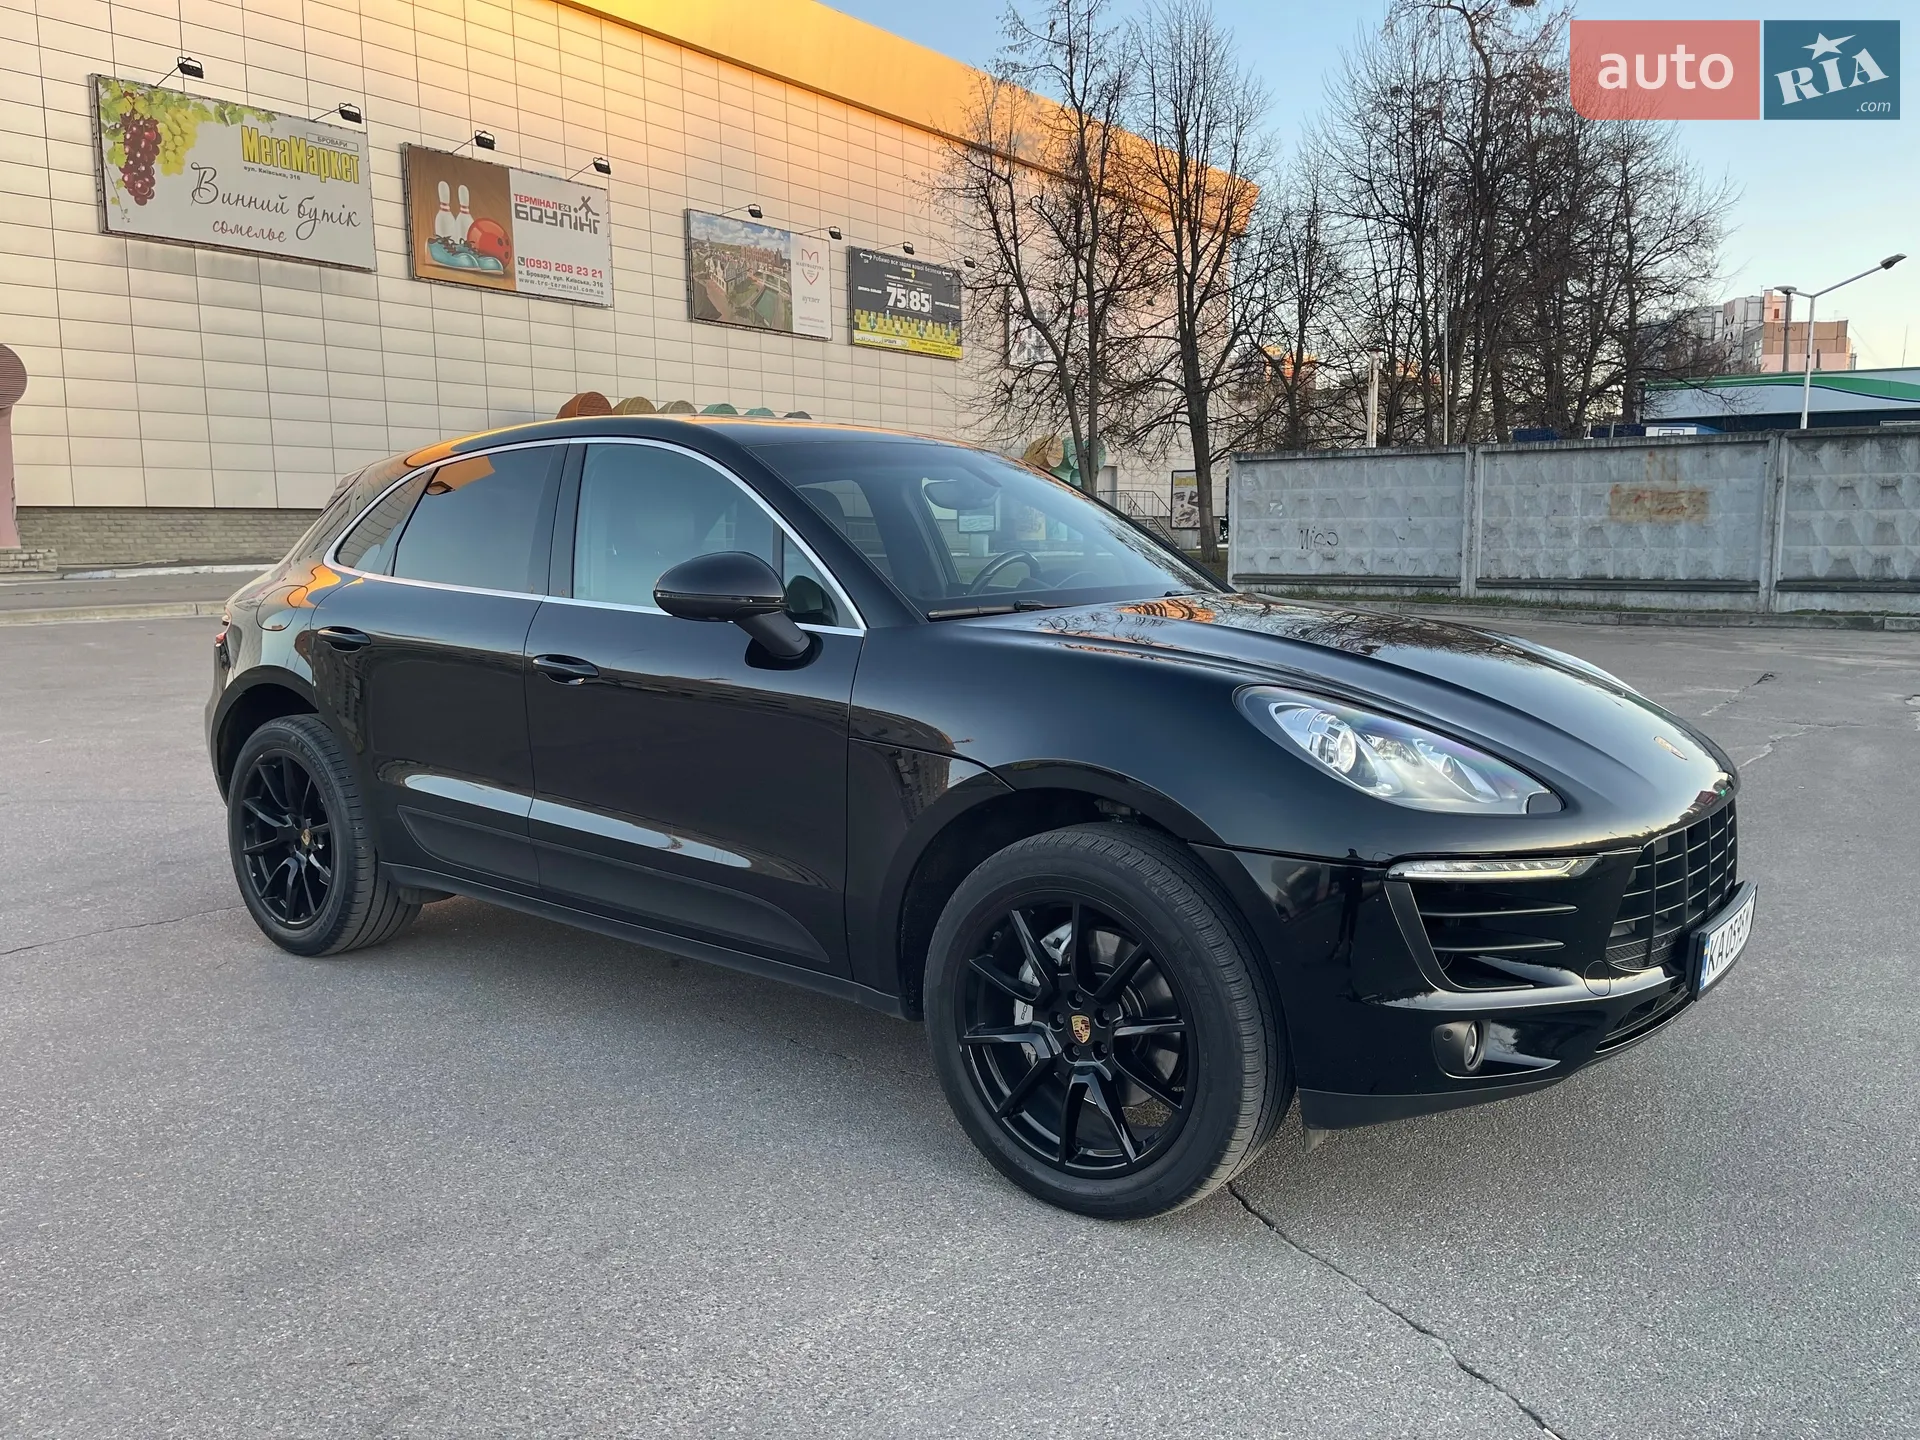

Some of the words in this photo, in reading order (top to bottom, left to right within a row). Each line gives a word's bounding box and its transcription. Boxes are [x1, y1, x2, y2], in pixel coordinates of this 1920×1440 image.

[241, 125, 360, 184] МегаМаркет
[317, 136, 348, 148] БРОВАРИ
[190, 162, 290, 215] Винний
[295, 196, 361, 241] бутік
[513, 193, 557, 210] ТЕРМІНАЛ
[212, 219, 287, 243] сомельє
[514, 203, 600, 234] БОУЛІНГ
[525, 258, 552, 272] (093)
[554, 262, 573, 274] 208
[576, 266, 589, 277] 23
[591, 269, 603, 279] 21
[886, 285, 906, 309] 75
[909, 290, 930, 313] 85
